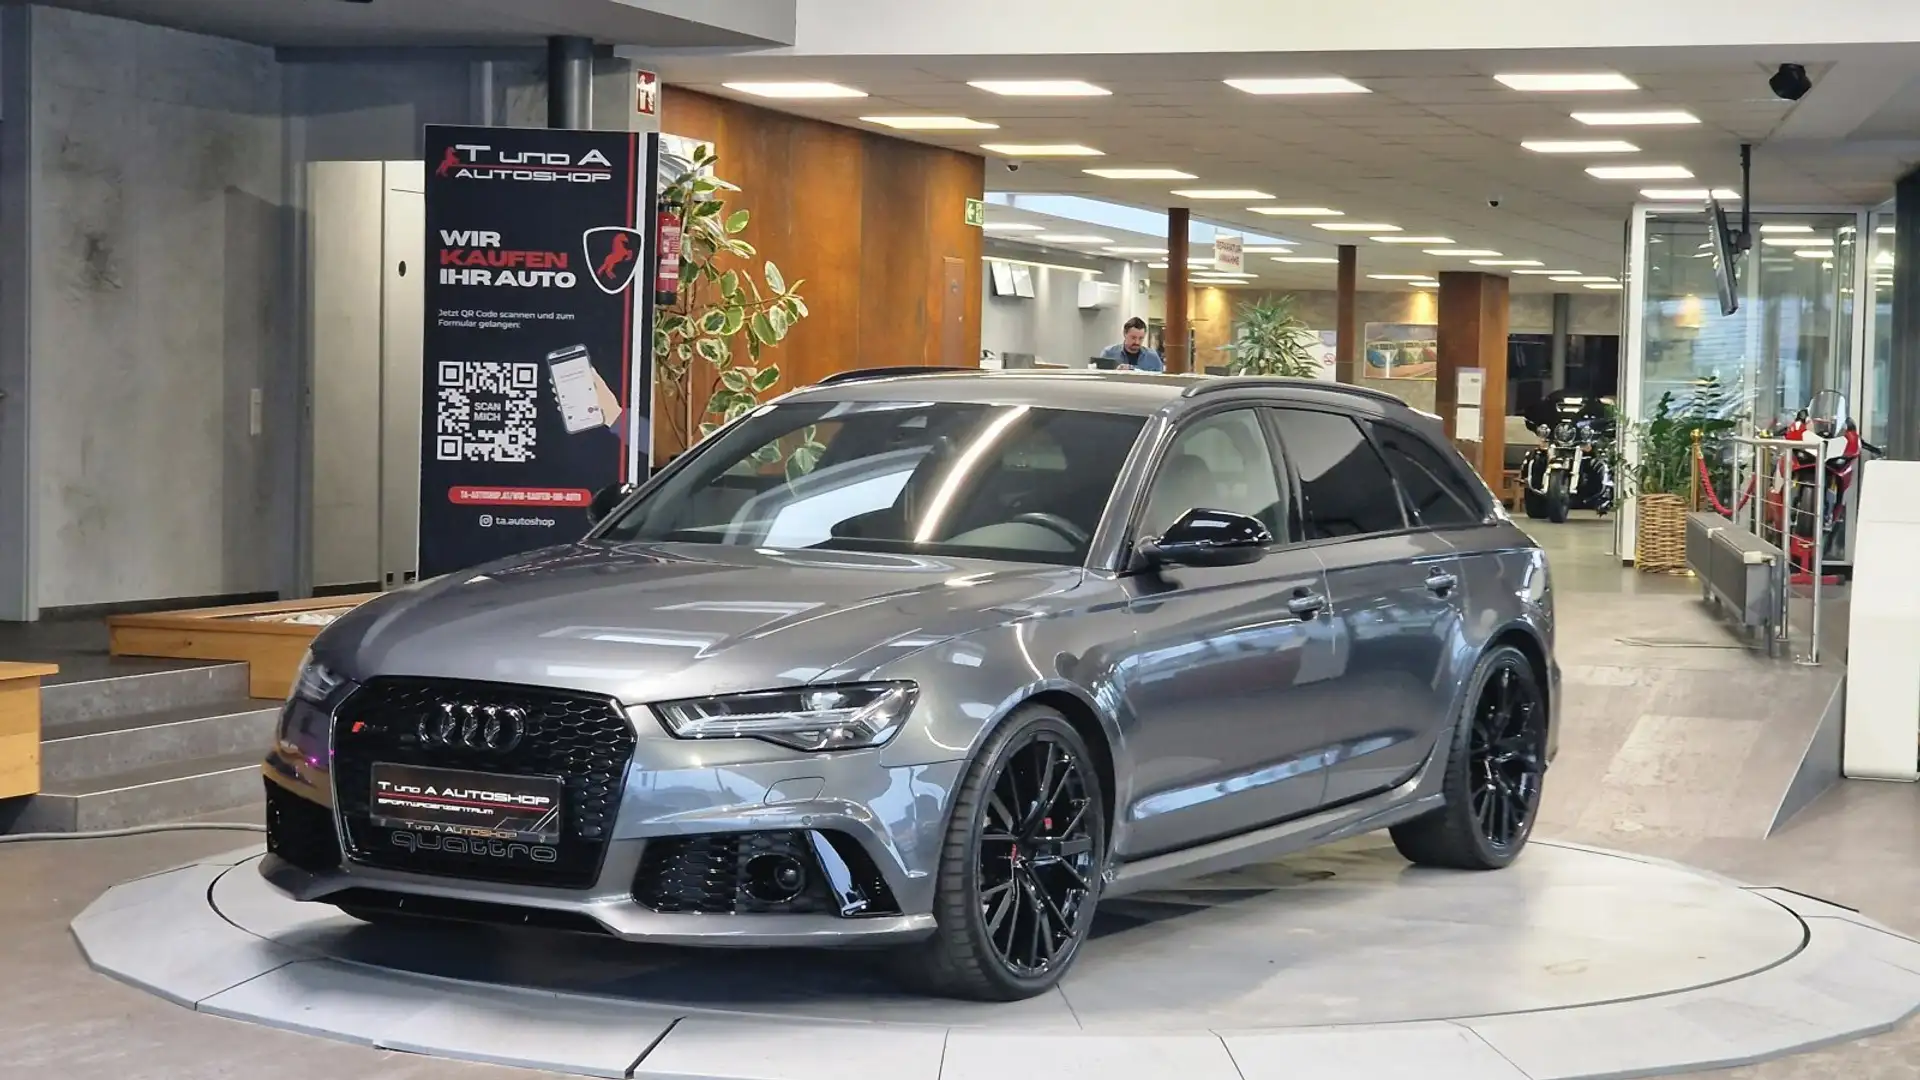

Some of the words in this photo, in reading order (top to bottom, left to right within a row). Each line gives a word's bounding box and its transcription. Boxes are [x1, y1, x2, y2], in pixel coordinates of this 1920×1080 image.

[456, 144, 491, 162] T
[577, 149, 612, 167] A
[455, 168, 612, 183] AUTOSHOP
[440, 229, 501, 248] WIR
[440, 249, 568, 269] KAUFEN
[440, 268, 492, 286] IHR
[494, 270, 577, 288] AUTO
[438, 309, 459, 317] Jetzt
[460, 309, 474, 318] QR
[475, 310, 498, 318] Code
[499, 311, 535, 319] scannen
[537, 312, 554, 320] und
[438, 319, 477, 328] Formular
[474, 402, 502, 411] SCAN
[474, 411, 502, 421] MICH
[496, 517, 556, 528] ta.autoshop
[378, 781, 391, 791] T
[424, 786, 437, 795] A
[442, 787, 550, 805] AUTOSHOP
[406, 821, 414, 830] T
[431, 824, 441, 832] A
[445, 826, 518, 839] AUTOSHOP
[391, 831, 557, 863] quattro
